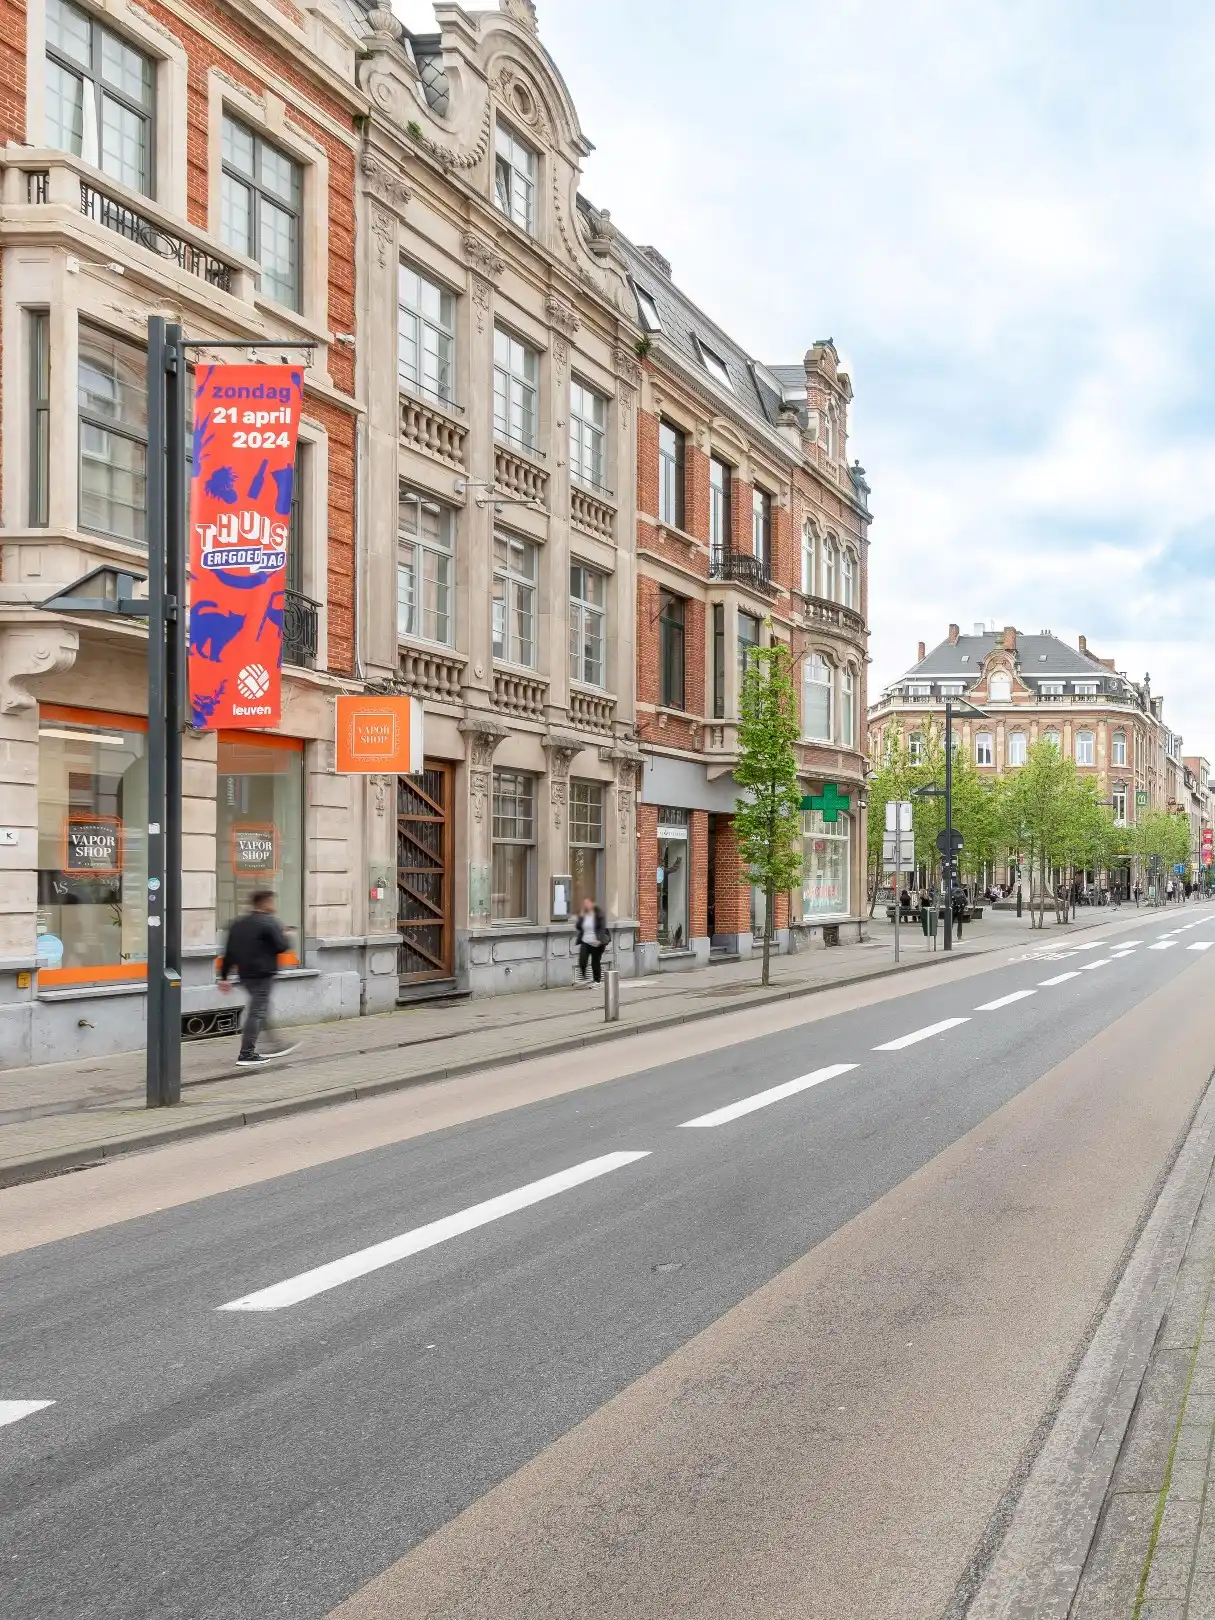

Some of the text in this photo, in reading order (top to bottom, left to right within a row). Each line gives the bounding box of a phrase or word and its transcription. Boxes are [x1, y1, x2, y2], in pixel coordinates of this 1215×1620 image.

[212, 384, 291, 403] zondag
[213, 407, 291, 427] 21 april
[232, 432, 290, 448] 2024
[195, 511, 287, 552] THUIS
[233, 704, 271, 716] leuven
[360, 735, 387, 744] SHOP
[72, 835, 116, 847] VAPOR
[239, 841, 273, 851] VAPOR
[75, 846, 112, 858] SHOP
[242, 851, 270, 861] SHOP
